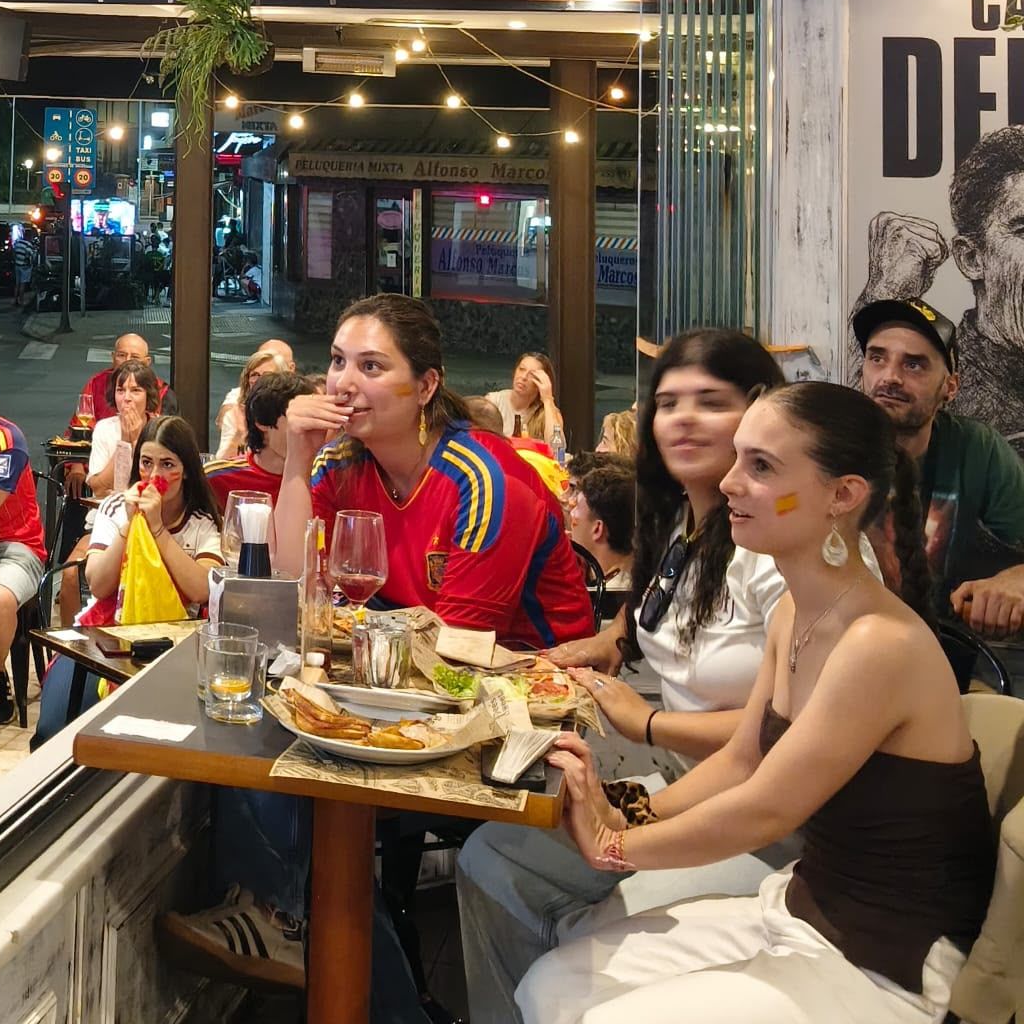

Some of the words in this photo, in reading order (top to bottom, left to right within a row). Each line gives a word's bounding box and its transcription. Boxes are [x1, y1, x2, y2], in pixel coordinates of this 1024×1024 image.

[367, 160, 404, 175] MIXTA
[414, 160, 479, 177] Alfonso
[491, 163, 550, 180] Marco
